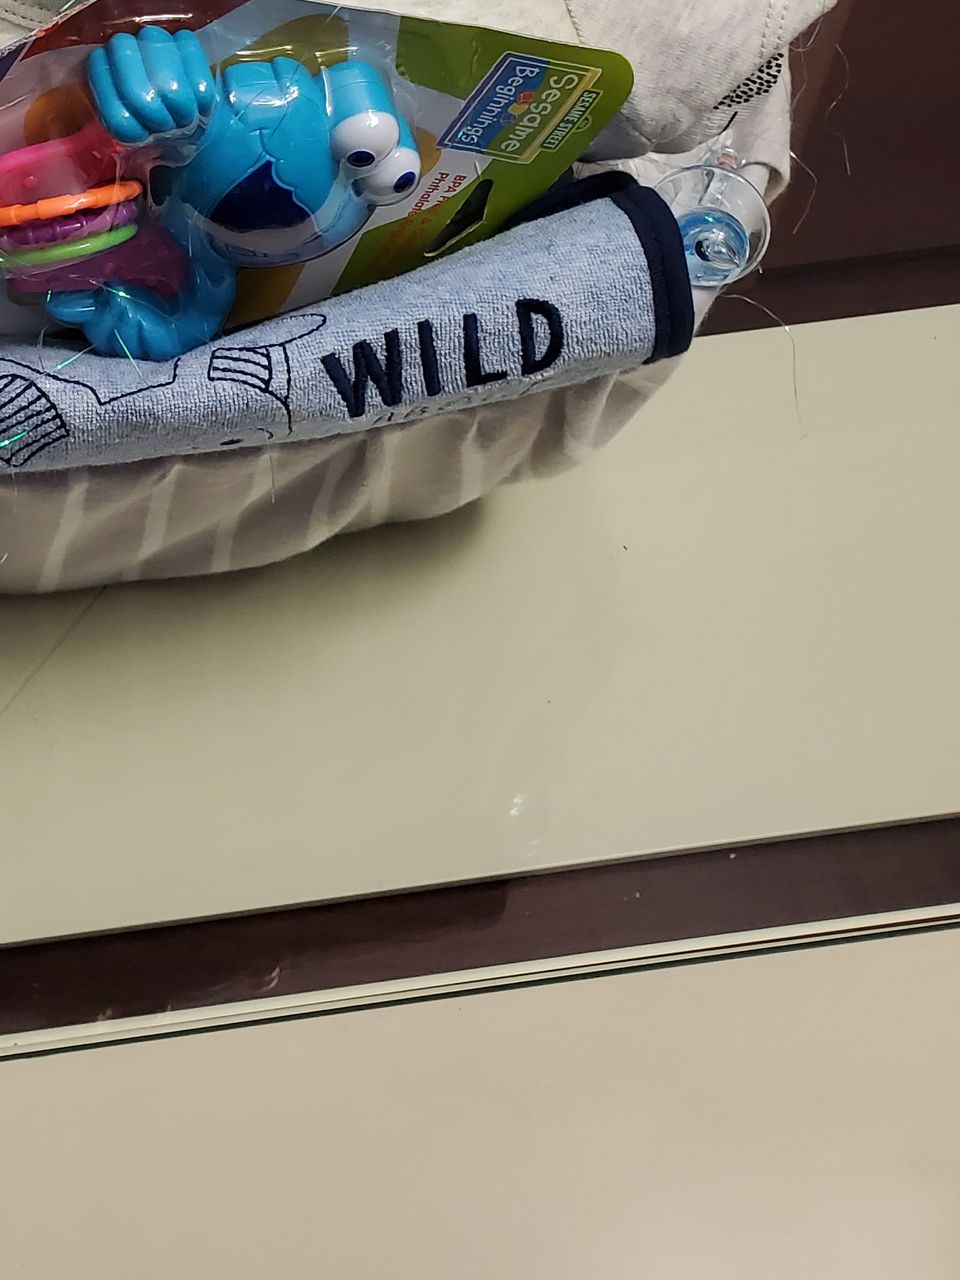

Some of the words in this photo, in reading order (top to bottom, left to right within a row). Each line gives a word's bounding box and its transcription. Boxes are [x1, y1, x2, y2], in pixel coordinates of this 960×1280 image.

[461, 65, 540, 144] Beginnings
[501, 73, 579, 153] Sesame
[565, 91, 597, 125] SESAME
[542, 121, 573, 150] STREET
[443, 174, 467, 194] BPA
[321, 298, 565, 418] WILD
